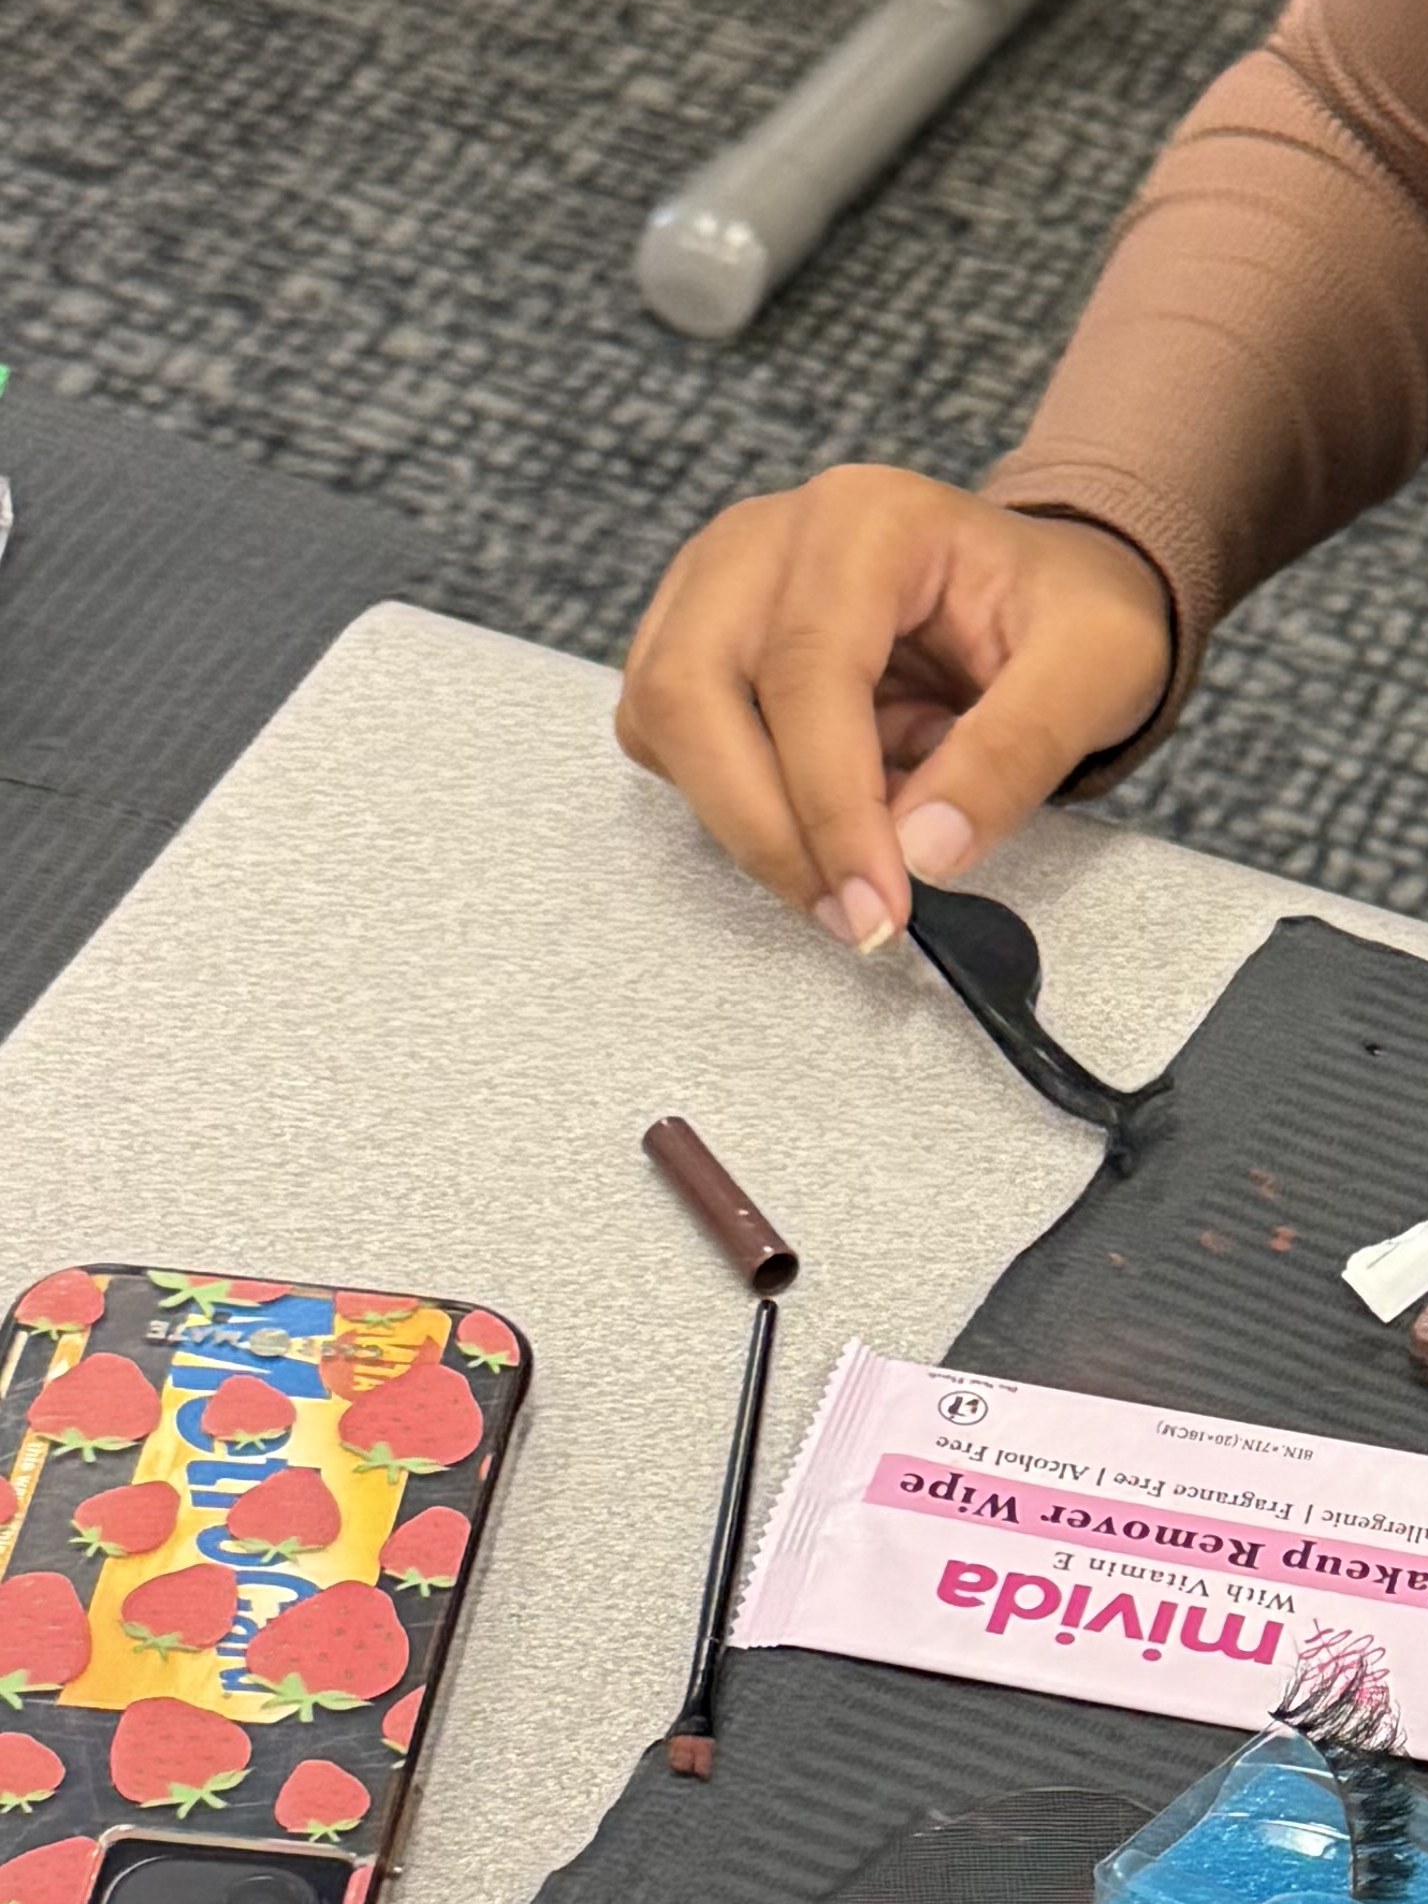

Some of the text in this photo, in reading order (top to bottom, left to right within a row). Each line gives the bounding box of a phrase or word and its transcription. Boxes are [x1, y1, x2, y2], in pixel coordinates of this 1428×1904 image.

[935, 1434, 989, 1463] Free
[995, 1451, 1089, 1482] Alcohol
[897, 1471, 1020, 1524] Wipe
[1113, 1470, 1166, 1498] Free
[1172, 1480, 1293, 1521] Fragrance
[1040, 1503, 1265, 1569] Remover
[1053, 1550, 1296, 1613] With Vitamin E
[936, 1560, 1283, 1665] mivida
